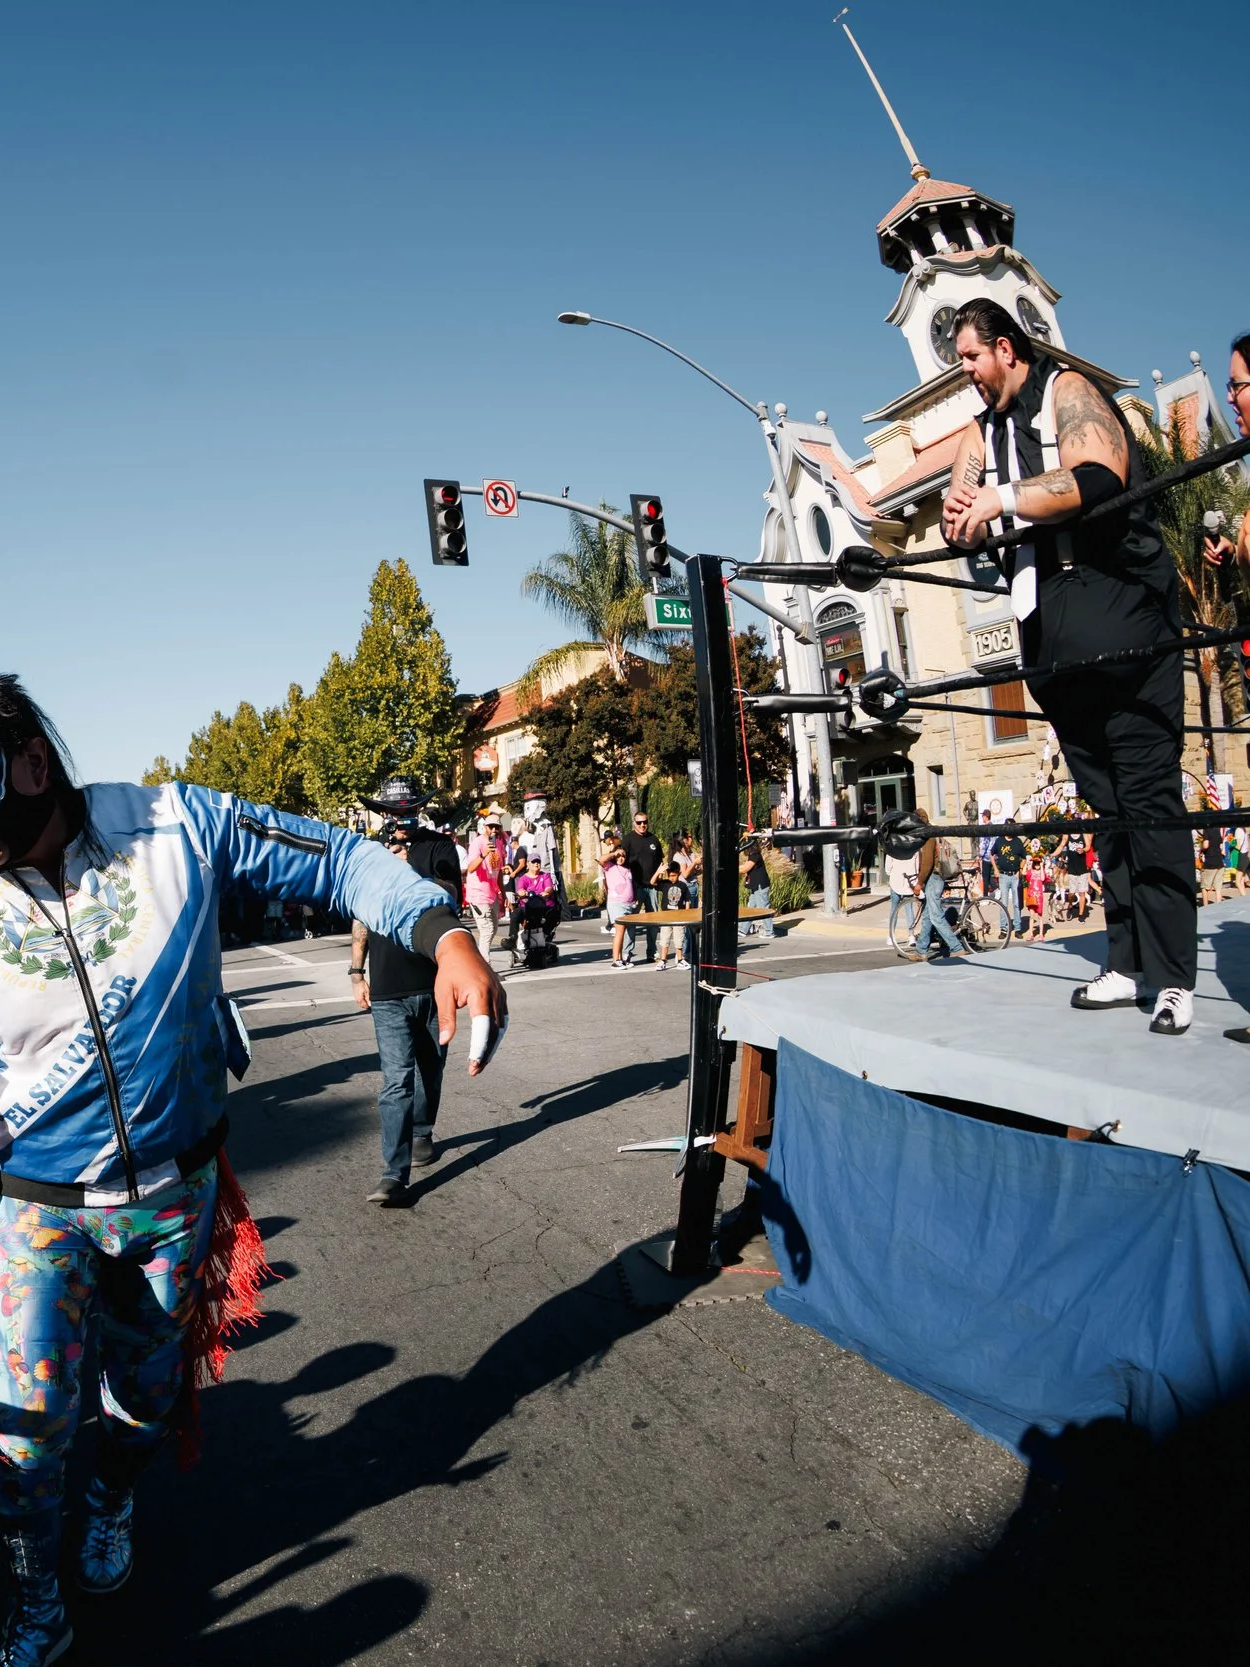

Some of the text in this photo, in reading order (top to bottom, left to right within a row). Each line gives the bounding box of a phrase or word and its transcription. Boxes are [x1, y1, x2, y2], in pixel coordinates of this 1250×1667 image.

[975, 628, 1013, 657] 1905
[3, 1101, 38, 1130] EL
[28, 974, 138, 1107] SALVADOR
